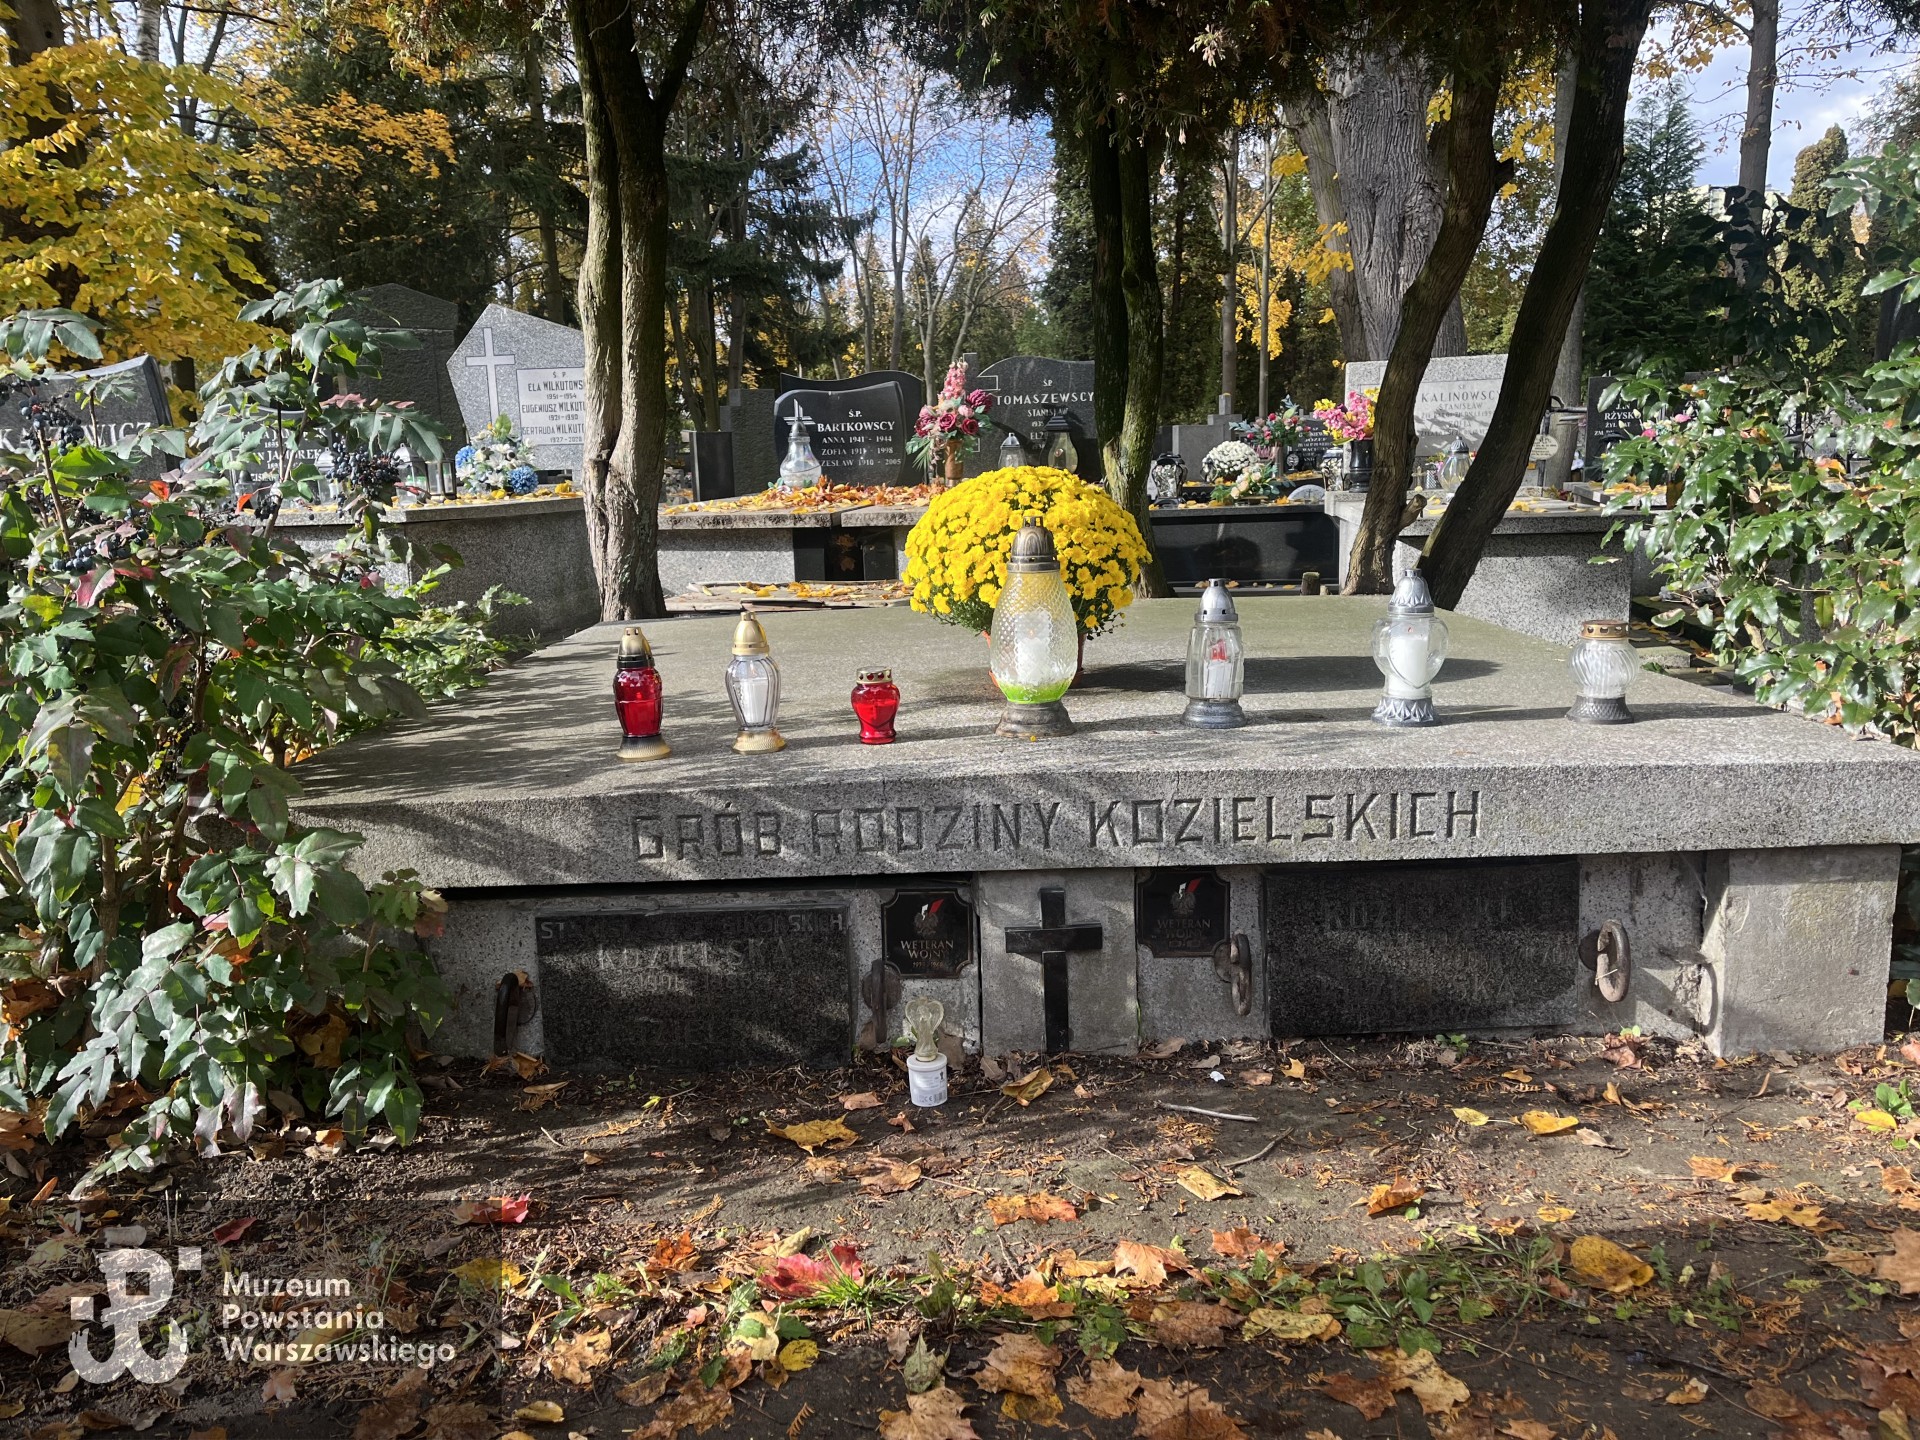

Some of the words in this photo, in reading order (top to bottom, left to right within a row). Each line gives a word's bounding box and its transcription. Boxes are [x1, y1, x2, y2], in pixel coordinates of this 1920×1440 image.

[527, 383, 542, 392] ELA
[543, 380, 584, 391] WILKUTOWS
[997, 391, 1094, 406] TOMASZEWSCY
[521, 404, 558, 413] EUGENIUSZ
[817, 421, 895, 432] BARTKOWSCY
[822, 436, 846, 444] ANNA
[821, 448, 847, 456] ZOFIA
[633, 801, 782, 859] GRÓB
[811, 801, 1062, 855] RODZINY
[1088, 790, 1480, 849] KOZIELSKICH
[900, 939, 954, 950] WETERAN
[908, 949, 948, 960] WOJNY
